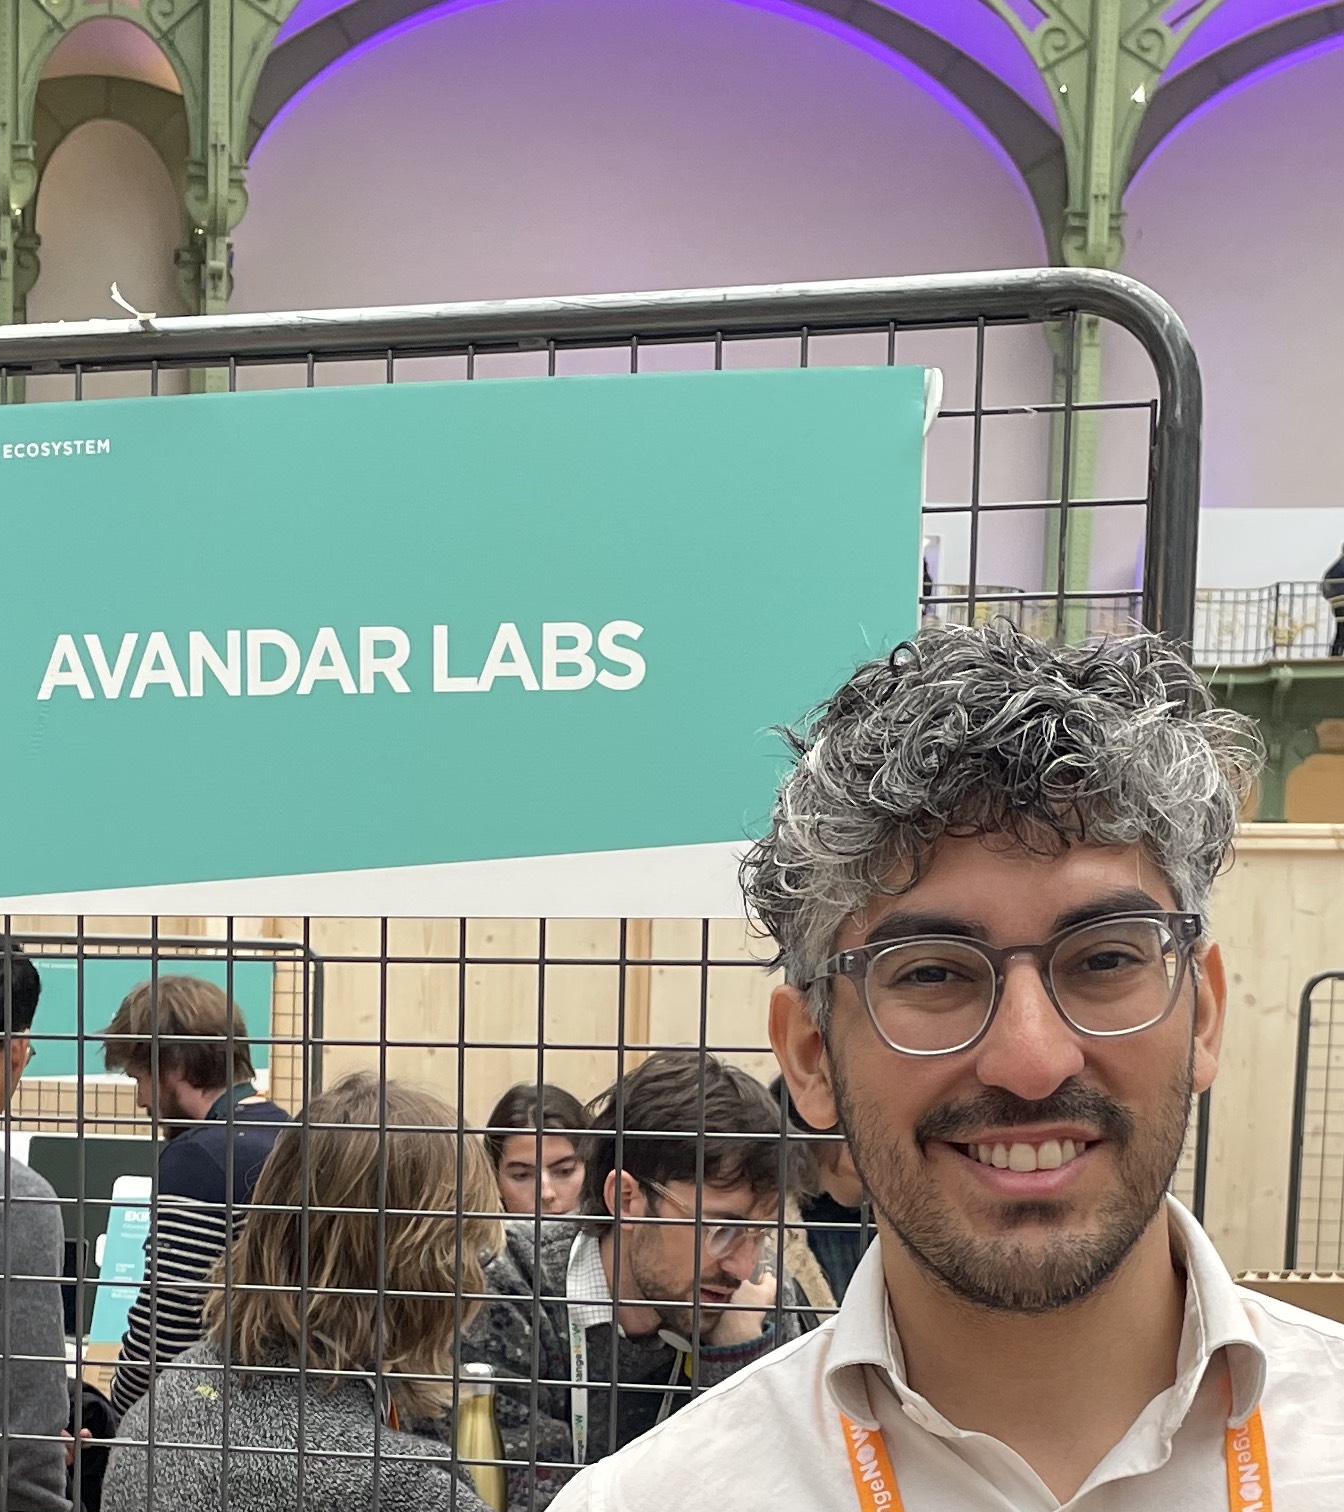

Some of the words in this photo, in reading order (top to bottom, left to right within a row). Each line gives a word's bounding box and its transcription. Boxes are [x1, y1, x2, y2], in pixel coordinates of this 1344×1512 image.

[2, 438, 111, 460] ECOSYSTEM
[37, 624, 411, 701] AVANDAR
[432, 619, 647, 695] LABS
